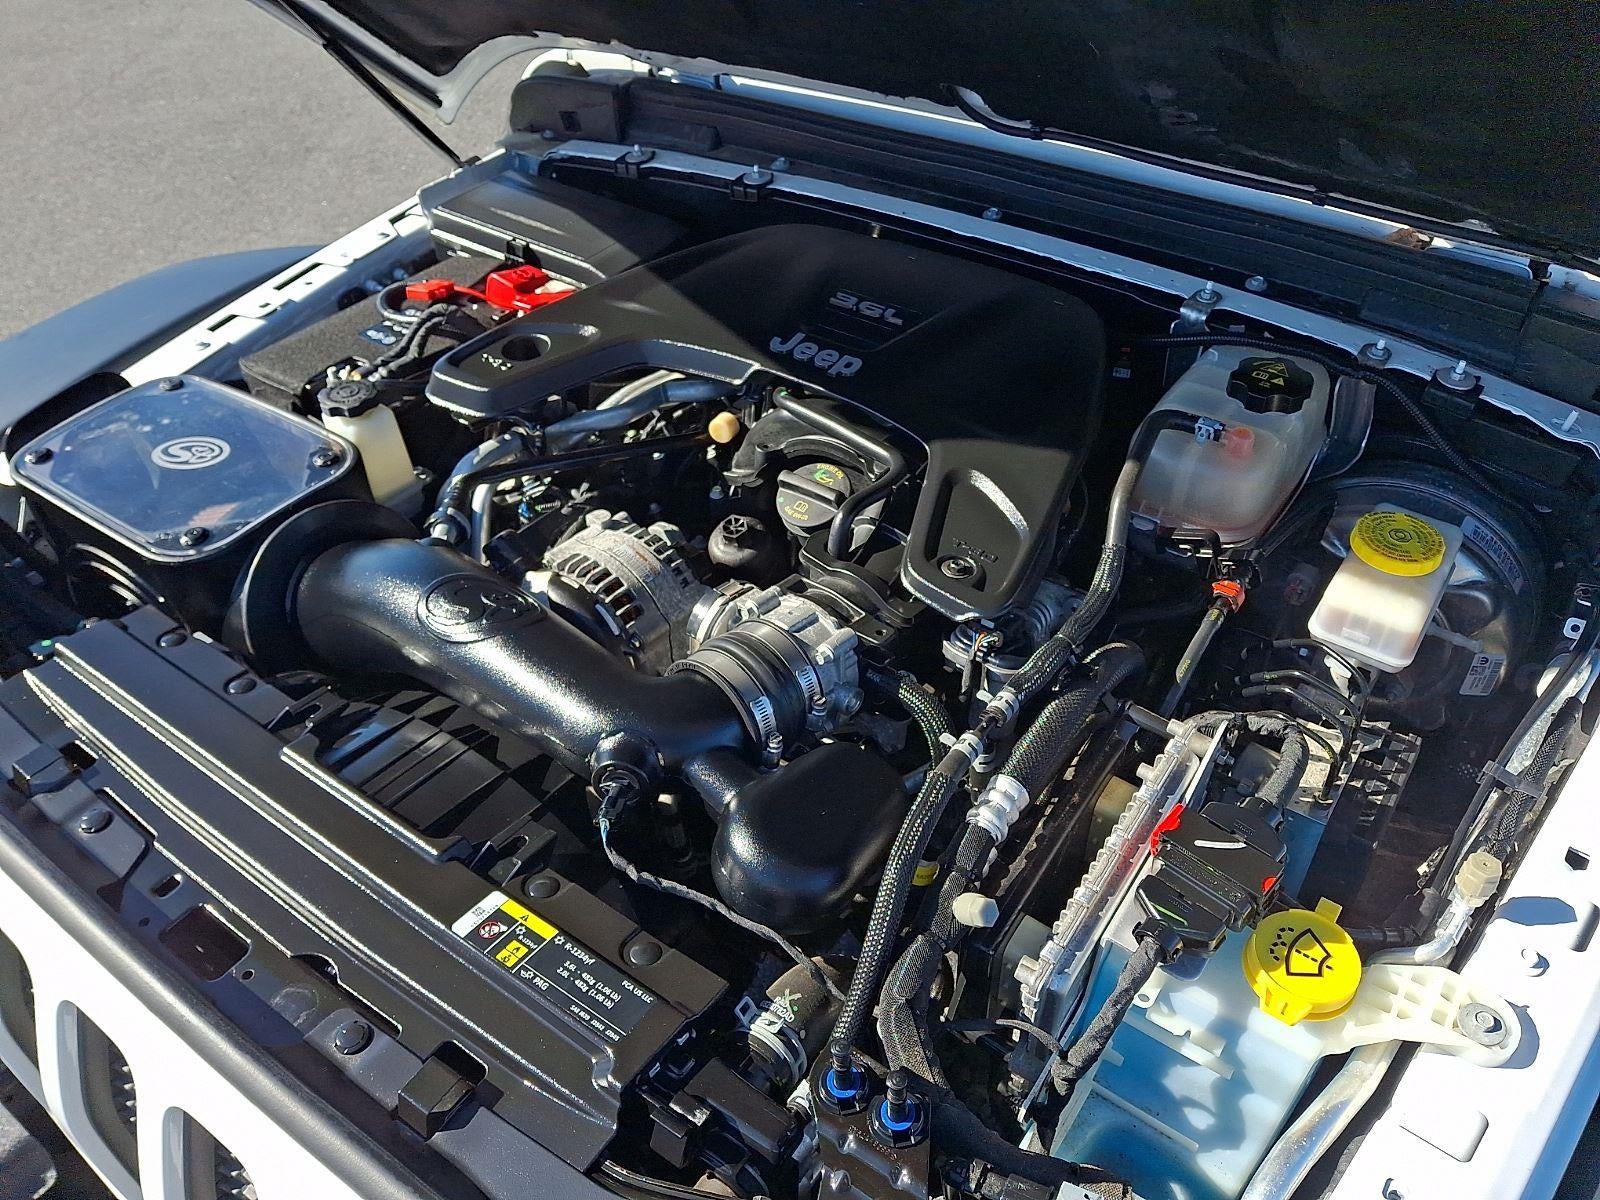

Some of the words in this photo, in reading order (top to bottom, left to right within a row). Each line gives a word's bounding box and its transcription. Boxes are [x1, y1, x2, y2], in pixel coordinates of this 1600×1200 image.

[769, 331, 862, 378] Jeep
[564, 943, 596, 965] R-1234yf
[564, 960, 576, 972] 3.6L
[532, 976, 550, 990] PAG
[622, 980, 632, 991] FCA
[633, 987, 643, 997] US
[642, 993, 654, 1003] LLC
